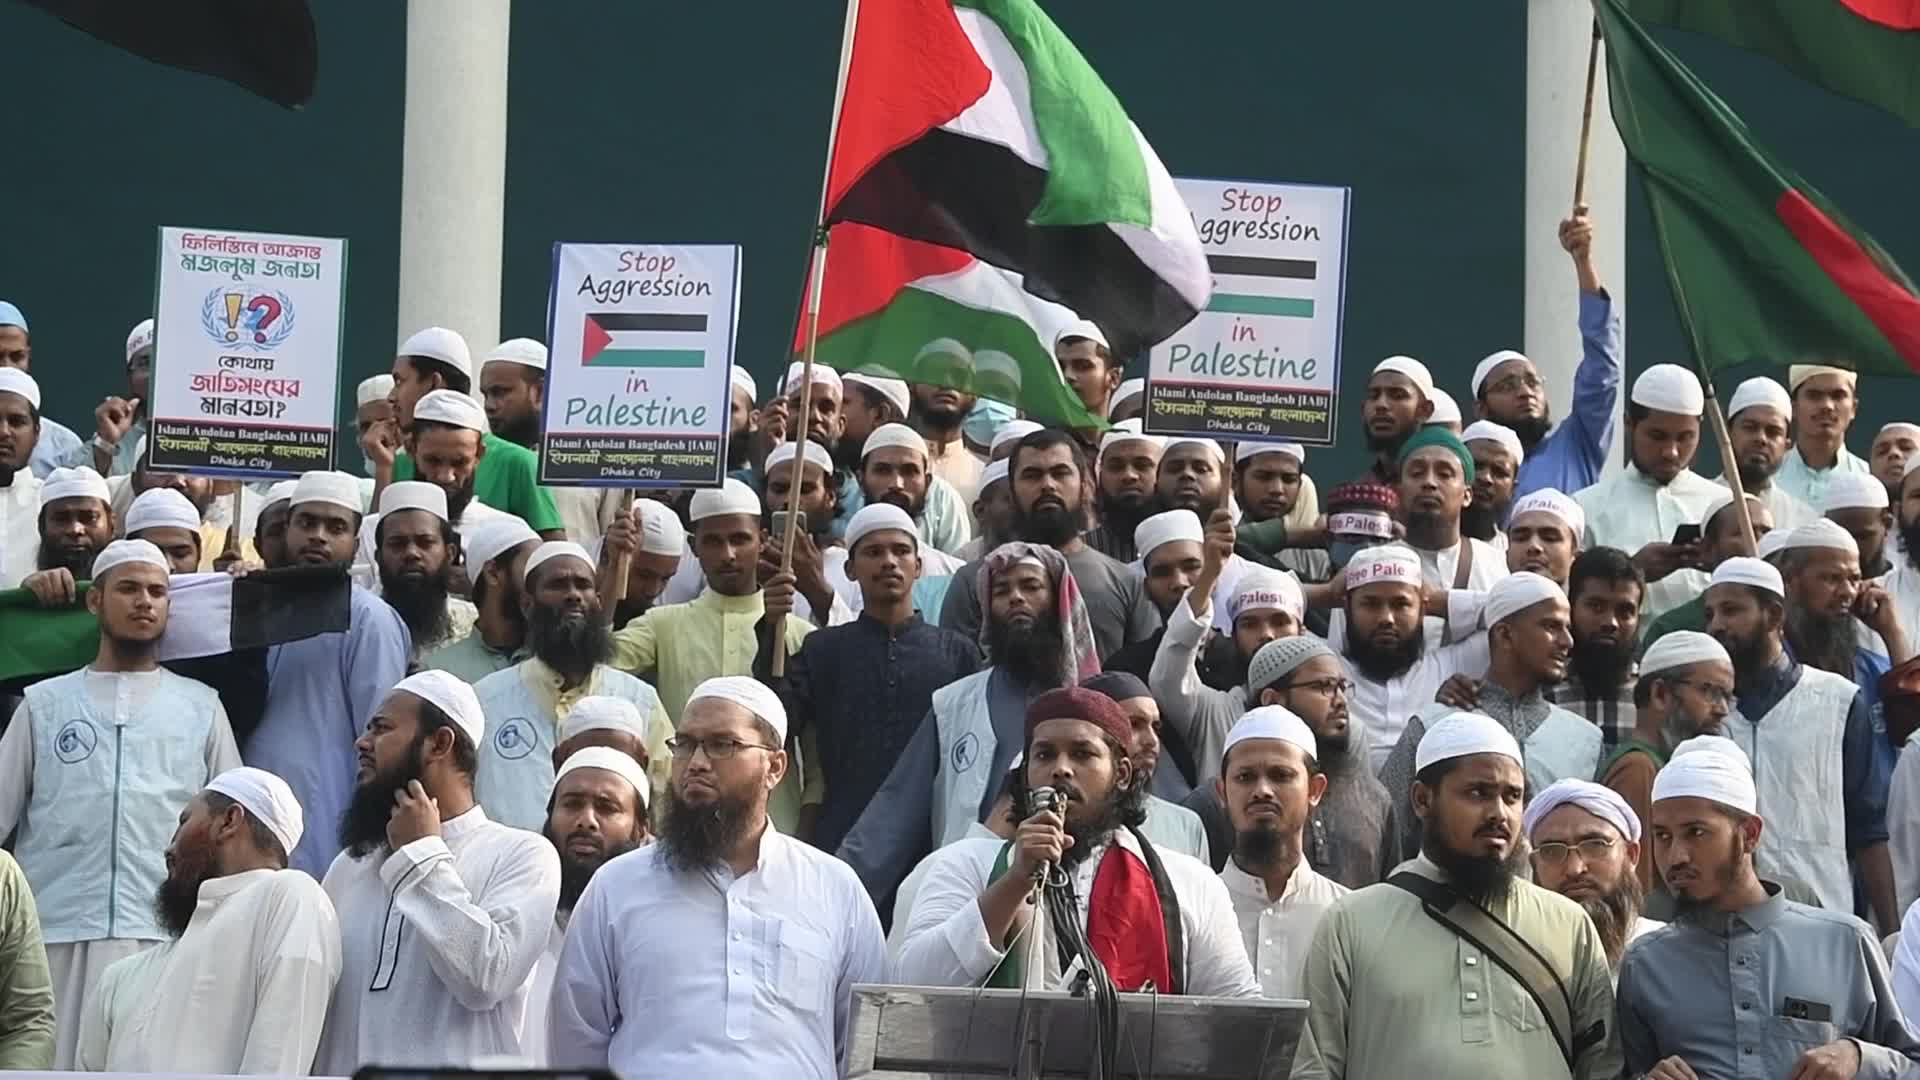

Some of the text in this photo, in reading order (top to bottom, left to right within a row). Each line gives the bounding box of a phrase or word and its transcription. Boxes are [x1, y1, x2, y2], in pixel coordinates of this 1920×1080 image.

[1221, 188, 1282, 221] Stop
[1190, 210, 1320, 245] ggression
[181, 233, 321, 260] ফিলিস্তিনে আক্রান্ত
[262, 259, 320, 280] জনতা
[617, 250, 676, 280] Stop
[577, 273, 712, 304] Aggression
[1232, 316, 1256, 342] in
[218, 355, 275, 372] কোথায়
[1168, 341, 1317, 381] Palestine
[189, 369, 300, 399] জাতিসংঘের
[625, 369, 649, 394] in
[200, 396, 287, 419] মানবতা?
[1153, 386, 1186, 398] Islami
[1187, 388, 1233, 401] Andolan
[1235, 391, 1295, 405] Bangladesh
[564, 393, 707, 427] Palestine
[157, 423, 190, 436] Islami
[192, 425, 236, 438] Andolan
[238, 427, 297, 443] Bangladesh
[1206, 419, 1271, 435] Dhaka City
[550, 438, 582, 449] Islami
[583, 439, 626, 450] Andolan
[628, 439, 686, 452] Bangladesh
[210, 455, 273, 470] Dhaka City
[600, 466, 662, 479] Dhaka City
